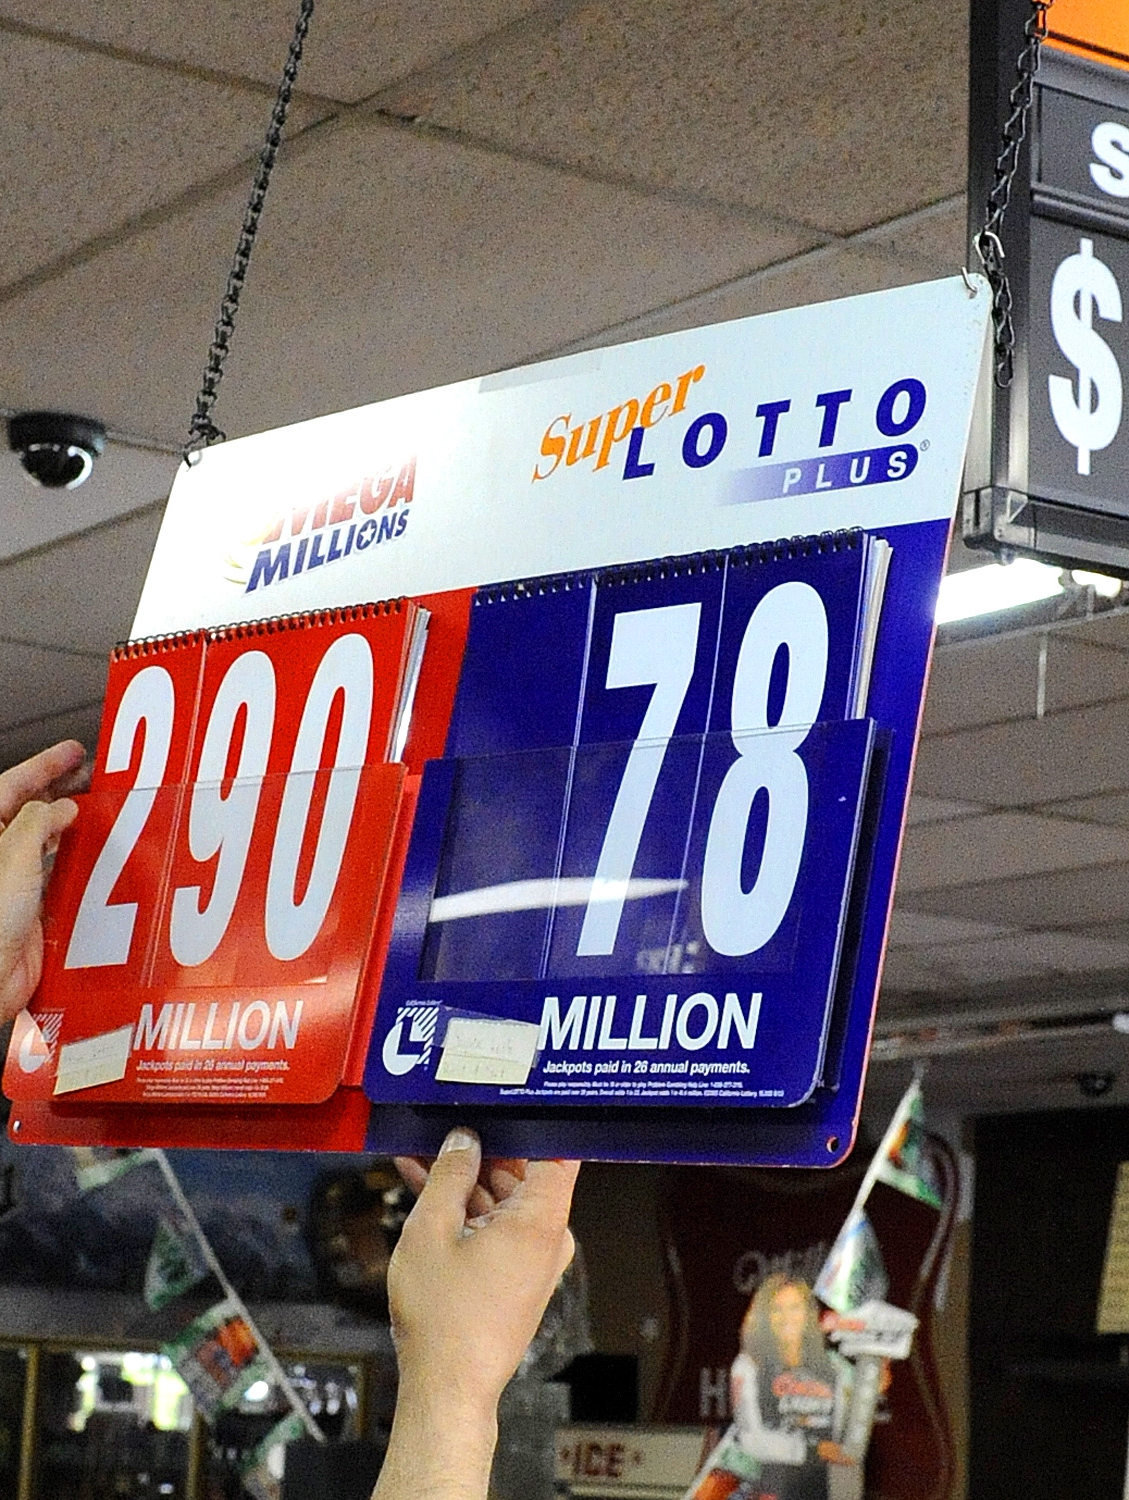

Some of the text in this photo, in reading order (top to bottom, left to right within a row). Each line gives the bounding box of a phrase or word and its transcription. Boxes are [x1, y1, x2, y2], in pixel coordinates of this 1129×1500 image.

[1047, 238, 1124, 475] $
[532, 364, 707, 484] Super
[623, 378, 927, 480] LOTTO
[262, 453, 417, 545] MEGA
[781, 451, 907, 494] PLUS
[245, 509, 410, 593] MILLIONS
[65, 633, 374, 970] 290
[576, 581, 829, 958] 78
[133, 1000, 304, 1050] MILLION
[539, 992, 762, 1051] MILLION
[543, 1060, 592, 1076] Jackpots
[594, 1060, 619, 1076] paid
[621, 1061, 631, 1073] in
[649, 1060, 689, 1073] annual
[689, 1060, 750, 1076] payments.
[572, 1443, 625, 1477] ICE
